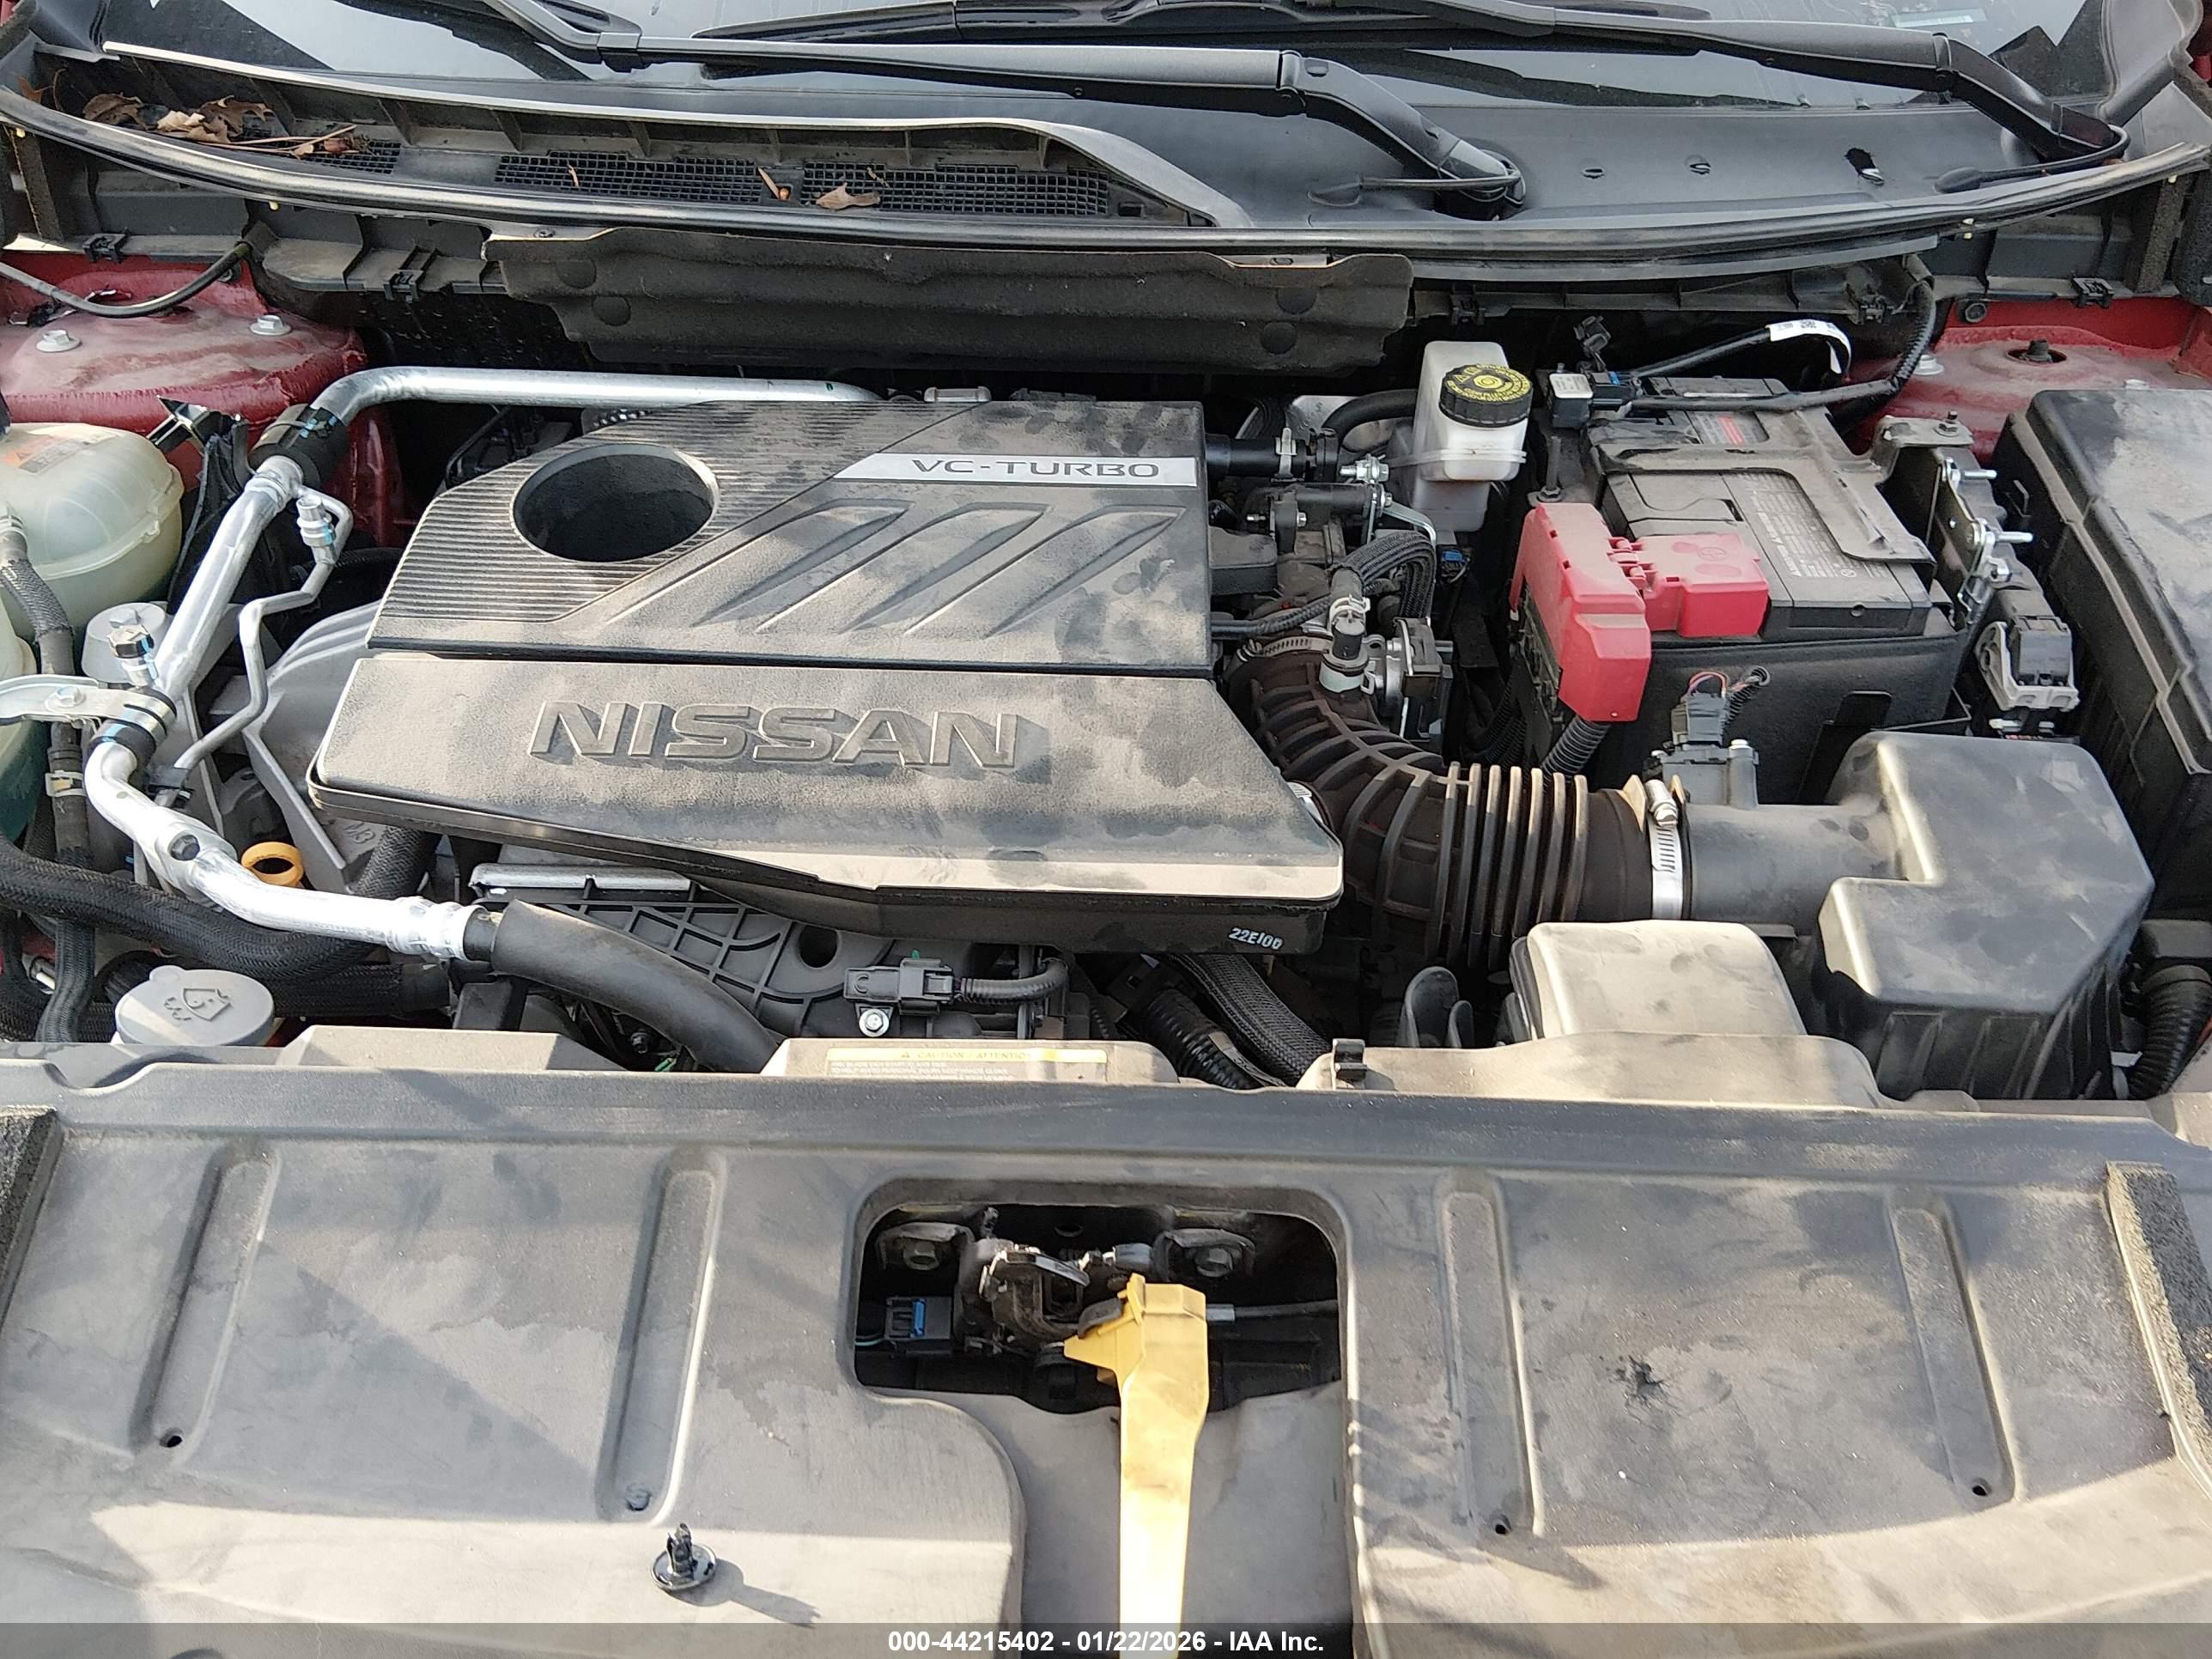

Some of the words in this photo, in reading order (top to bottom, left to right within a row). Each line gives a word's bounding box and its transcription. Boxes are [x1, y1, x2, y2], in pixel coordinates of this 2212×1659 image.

[912, 459, 1160, 478] VC-TURBO
[528, 701, 1018, 769] NISSAN
[917, 1051, 964, 1060] CAUTION
